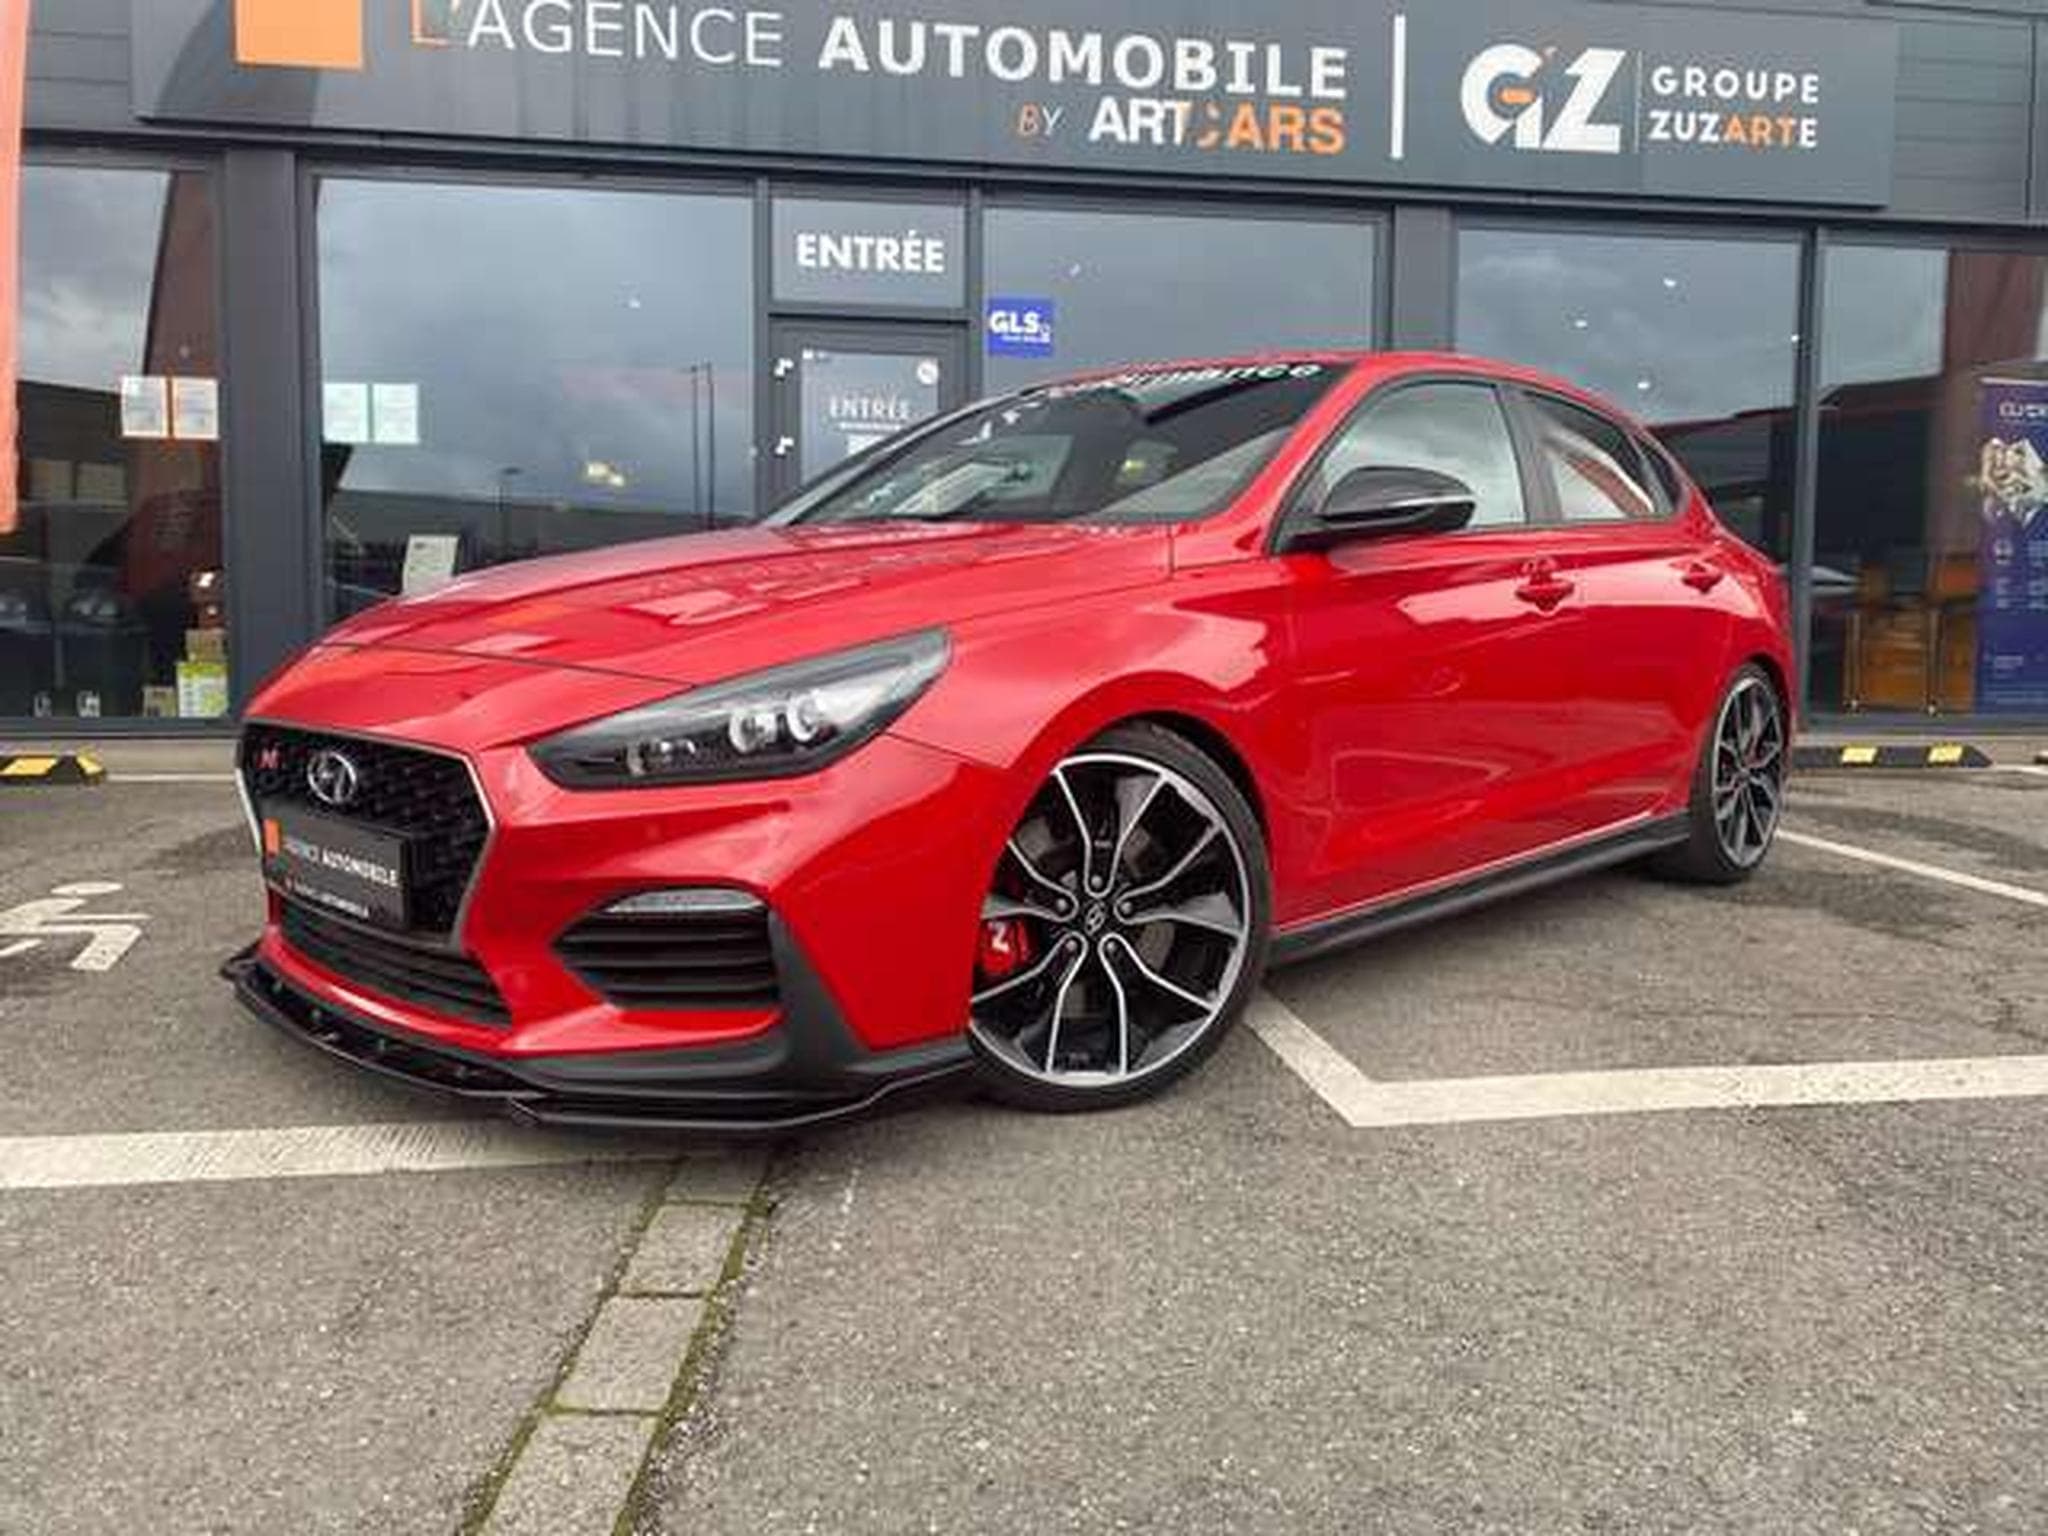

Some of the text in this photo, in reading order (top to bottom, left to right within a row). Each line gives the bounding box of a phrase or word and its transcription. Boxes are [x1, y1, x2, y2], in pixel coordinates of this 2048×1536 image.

[818, 17, 1349, 99] AUTOMOBILE
[1650, 65, 1820, 104] GROUPE
[1018, 103, 1063, 138] BY
[1648, 109, 1818, 149] ZUZARTE
[796, 229, 944, 272] ENTRÉE
[990, 310, 1040, 334] GLS
